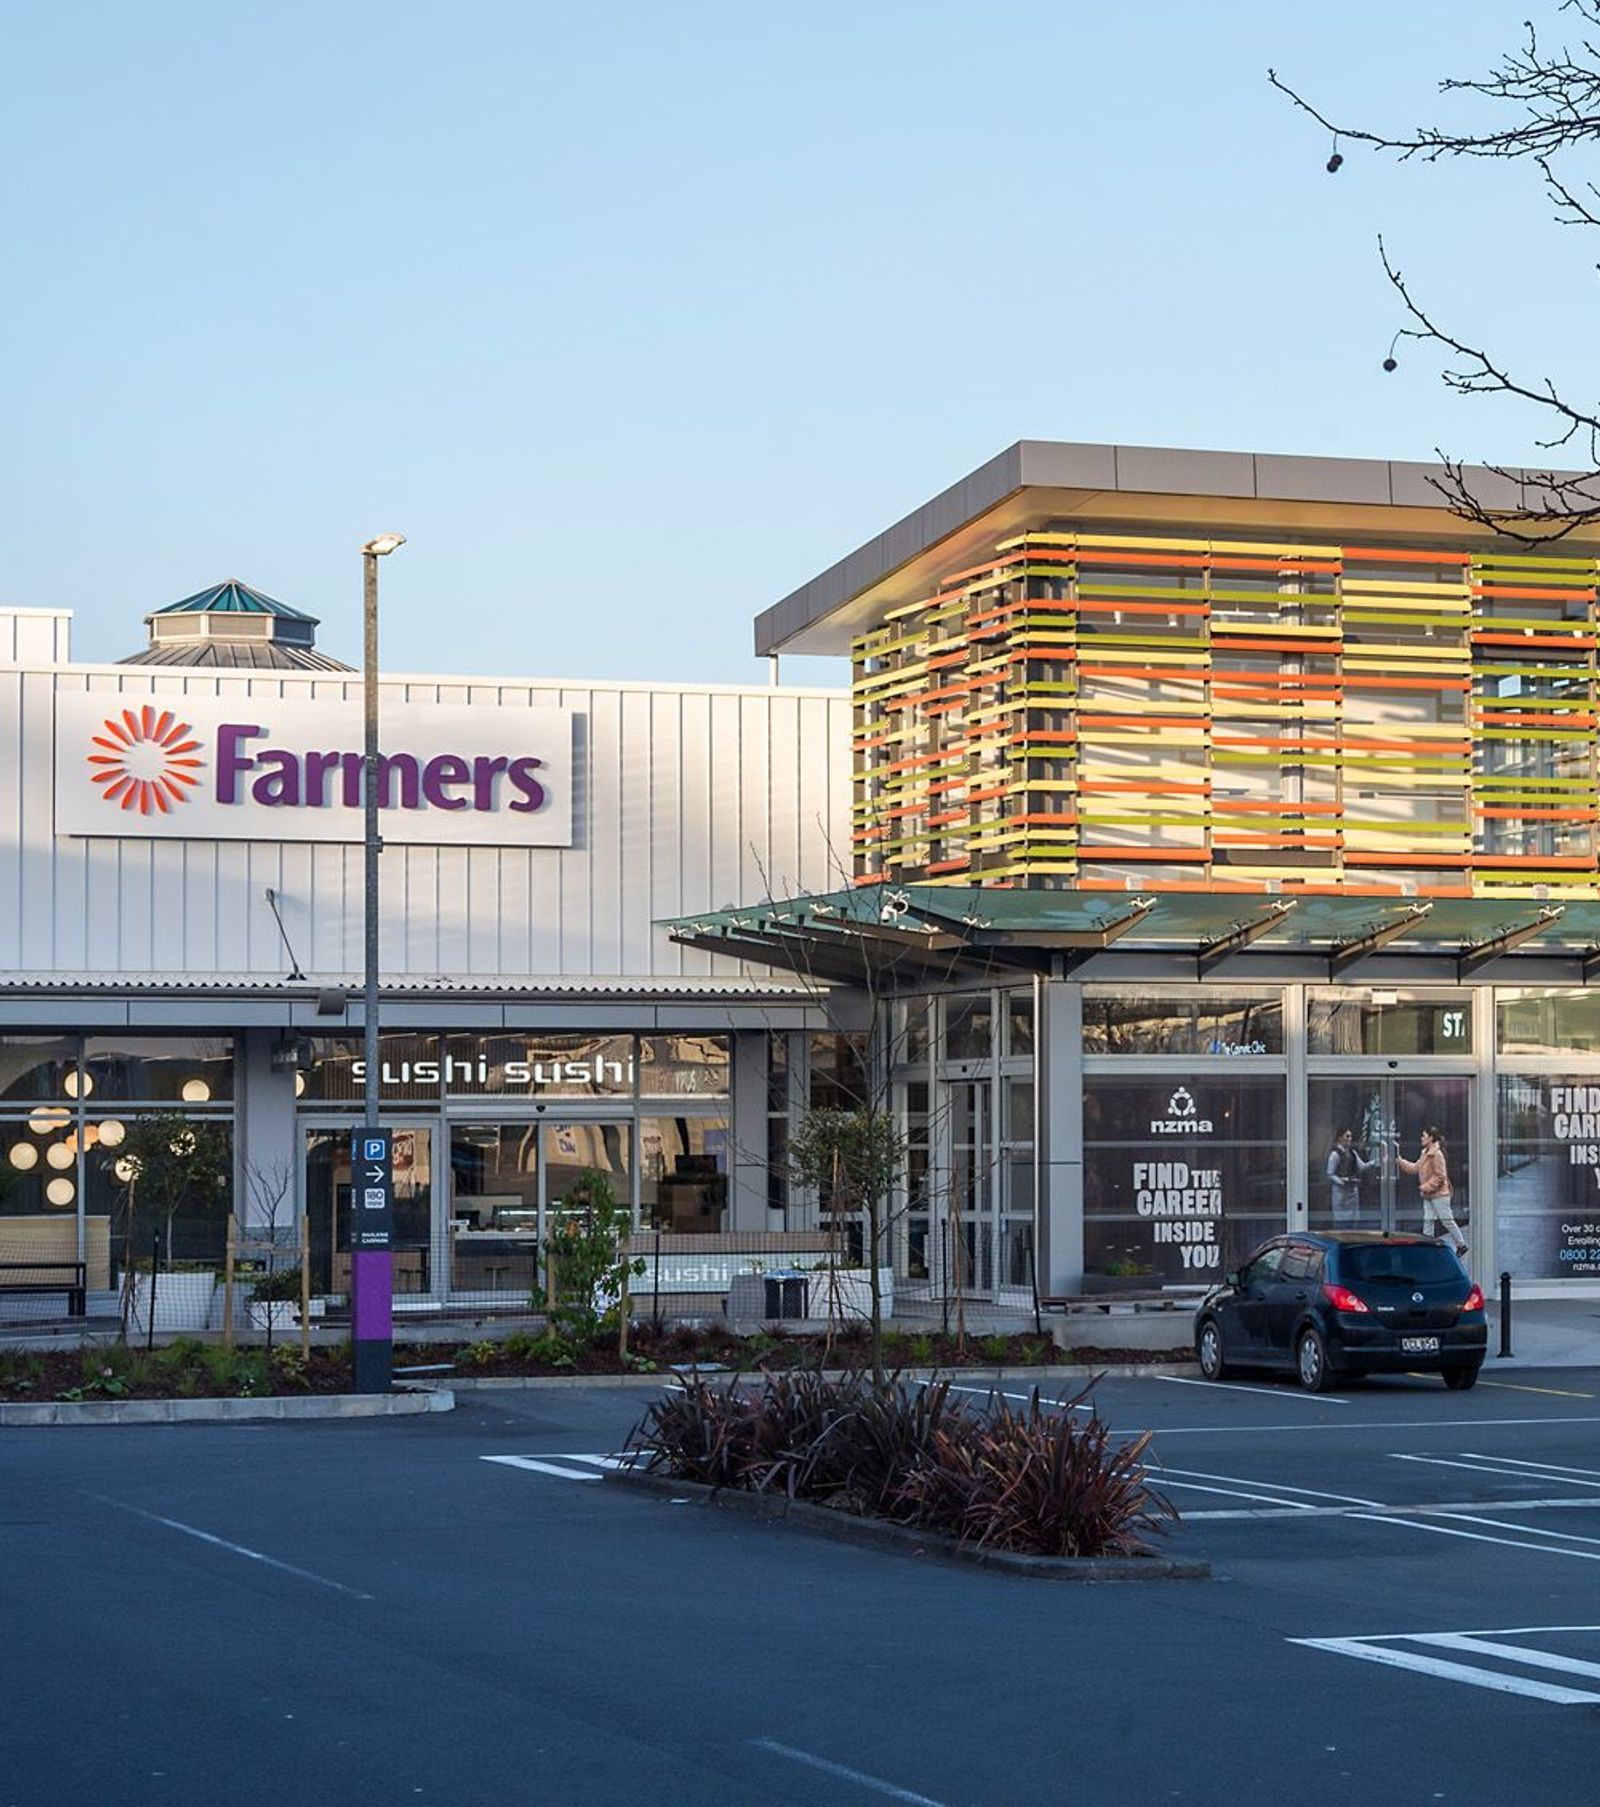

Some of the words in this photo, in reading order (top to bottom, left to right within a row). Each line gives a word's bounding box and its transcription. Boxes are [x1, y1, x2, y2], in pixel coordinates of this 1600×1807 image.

[216, 723, 545, 813] Farmers
[504, 1055, 634, 1085] sushi
[1151, 1120, 1214, 1134] nzma
[1133, 1162, 1189, 1190] FIND
[1191, 1170, 1222, 1189] THE
[1137, 1189, 1222, 1216] CAREER
[1154, 1221, 1215, 1243] INSIDE
[1561, 1223, 1582, 1234] Over
[1583, 1223, 1595, 1233] 30
[1179, 1245, 1221, 1269] YOU
